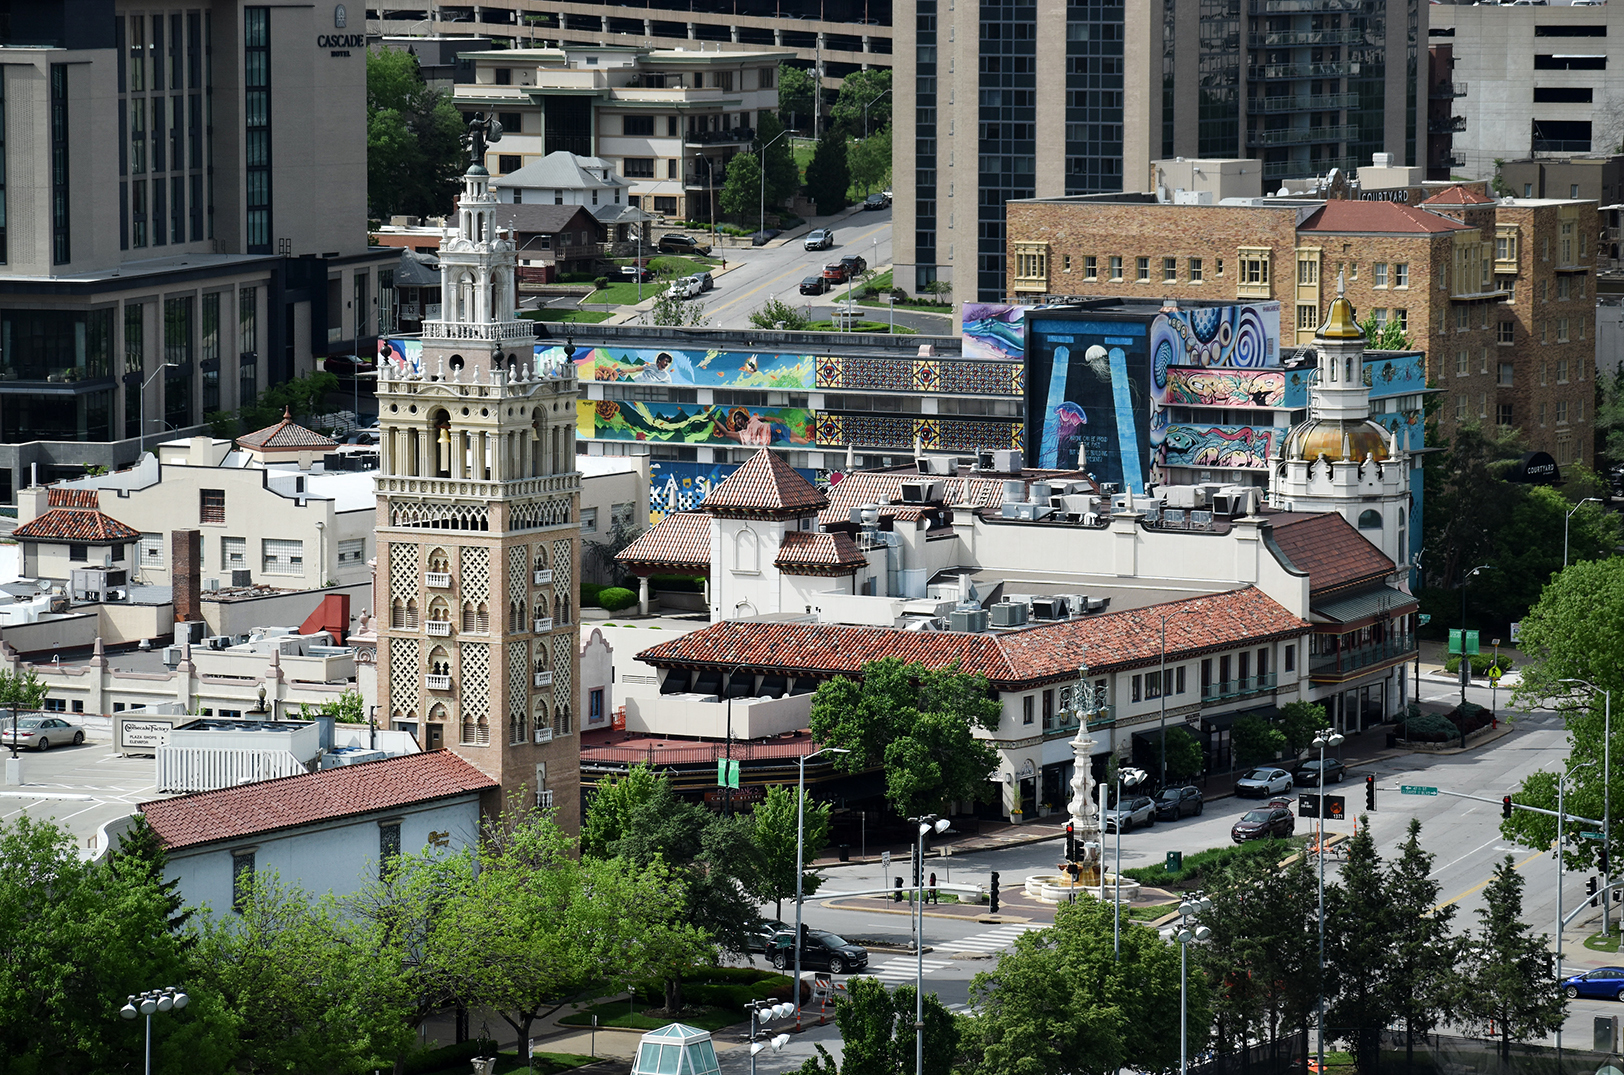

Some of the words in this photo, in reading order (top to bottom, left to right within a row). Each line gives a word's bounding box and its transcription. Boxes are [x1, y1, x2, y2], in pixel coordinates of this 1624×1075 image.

[317, 34, 365, 48] CASCADE
[330, 50, 352, 58] HOTEL
[1361, 190, 1409, 203] COURTYARD
[1527, 463, 1555, 475] COURTYARD
[149, 724, 170, 734] Factory
